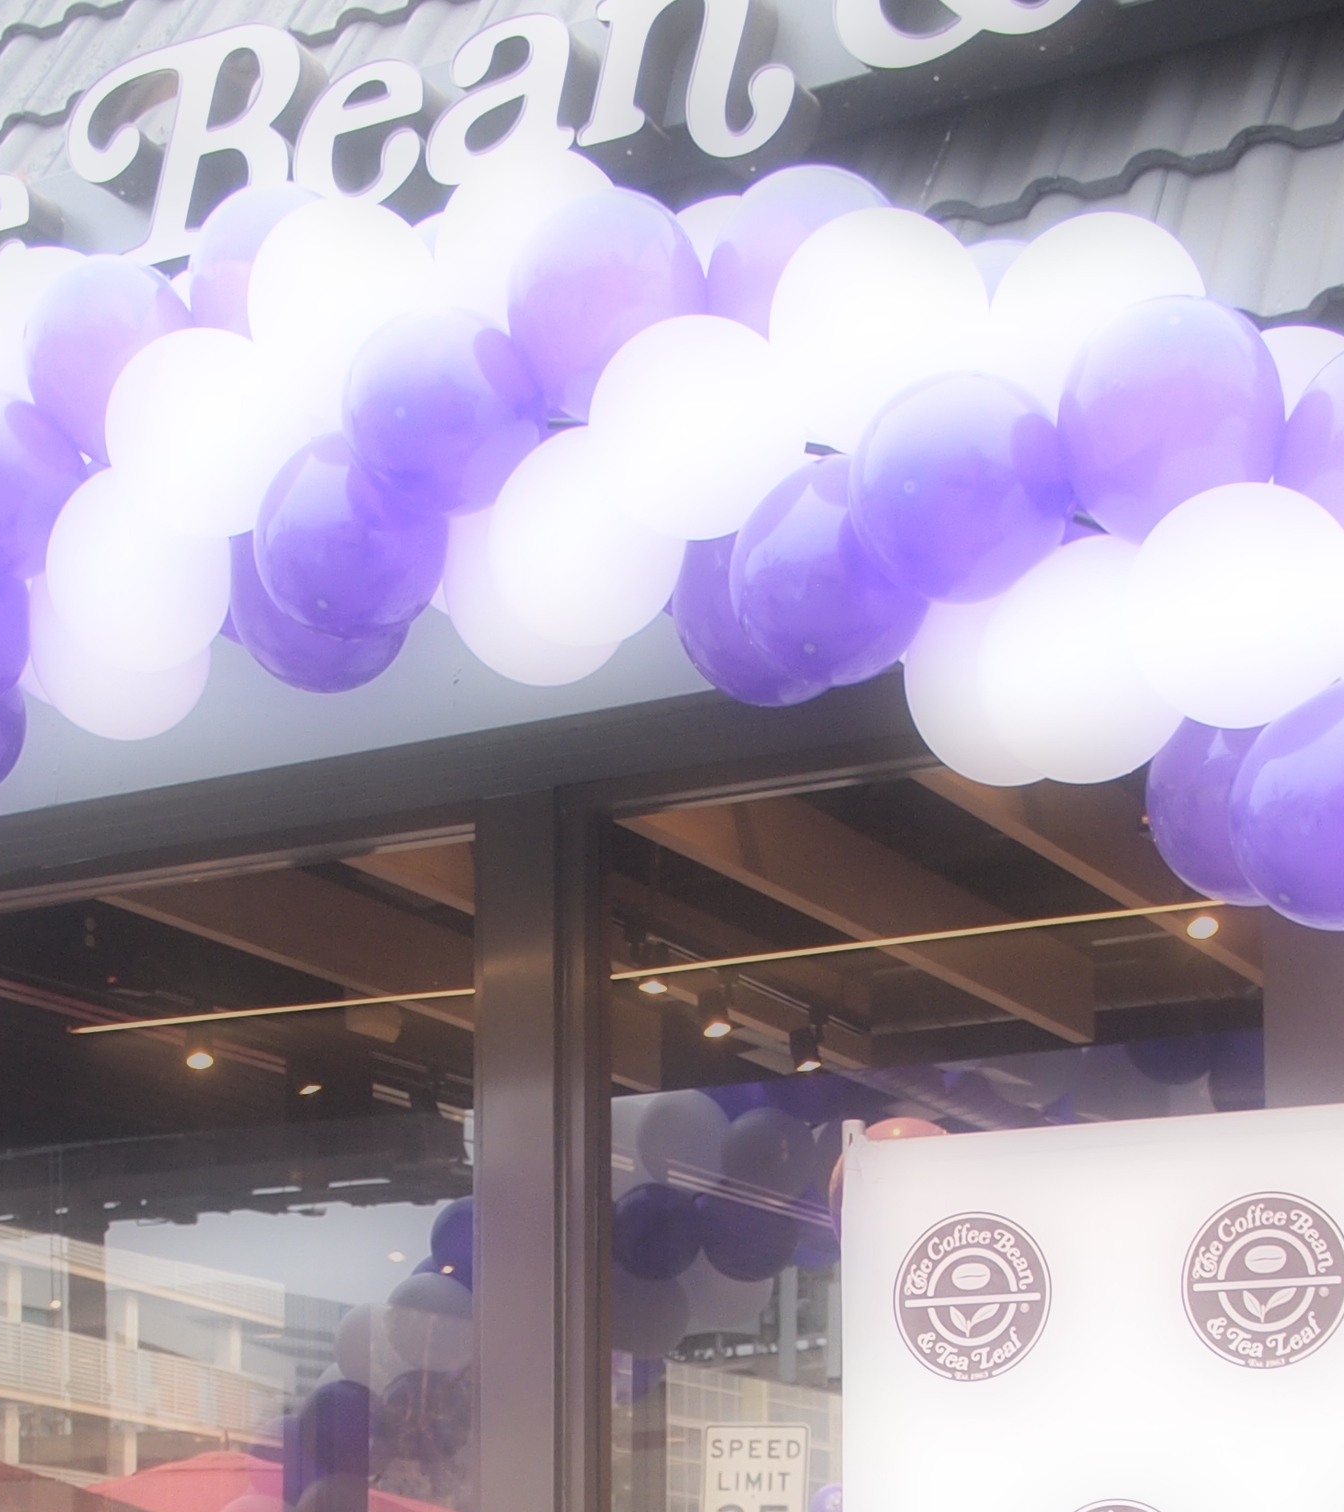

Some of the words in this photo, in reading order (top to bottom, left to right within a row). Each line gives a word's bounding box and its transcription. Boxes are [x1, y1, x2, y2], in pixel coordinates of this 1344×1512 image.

[67, 0, 796, 268] Bean
[903, 1258, 932, 1296] The
[927, 1222, 991, 1261] Coffee
[993, 1228, 1033, 1290] Bean
[1192, 1240, 1223, 1279] The
[1218, 1203, 1287, 1243] Coffee
[1289, 1209, 1333, 1273] Bean
[916, 1331, 936, 1354] &
[935, 1341, 969, 1371] Tea
[971, 1326, 1022, 1370] Leaf
[1206, 1316, 1227, 1340] &
[1226, 1327, 1264, 1358] Tea
[1266, 1310, 1321, 1356] Leaf
[711, 1439, 801, 1459] SPEED
[718, 1472, 791, 1492] LIMIT
